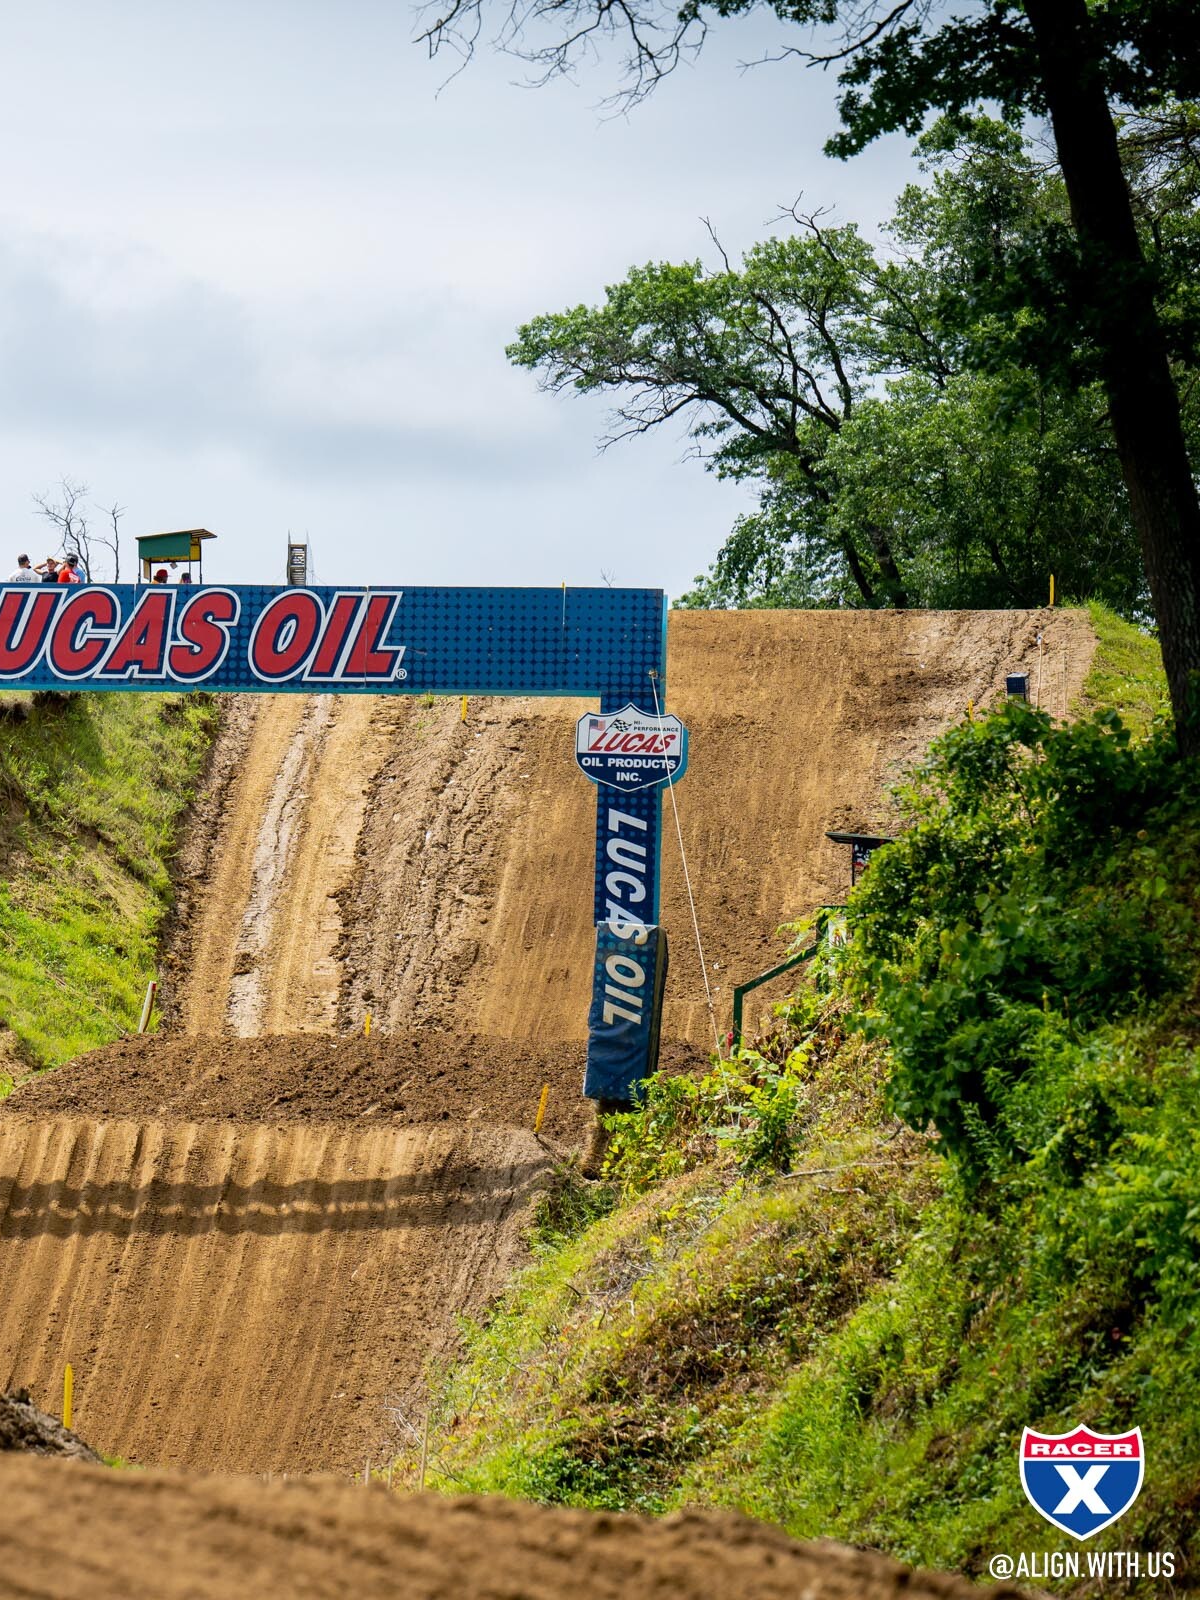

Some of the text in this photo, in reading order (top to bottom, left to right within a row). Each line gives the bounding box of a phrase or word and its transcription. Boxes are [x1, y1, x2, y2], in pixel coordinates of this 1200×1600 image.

[588, 732, 677, 754] LUCAS
[581, 757, 677, 769] OIL PRODUCTS
[616, 772, 642, 782] INC.
[602, 807, 648, 1025] LUCAS OIL
